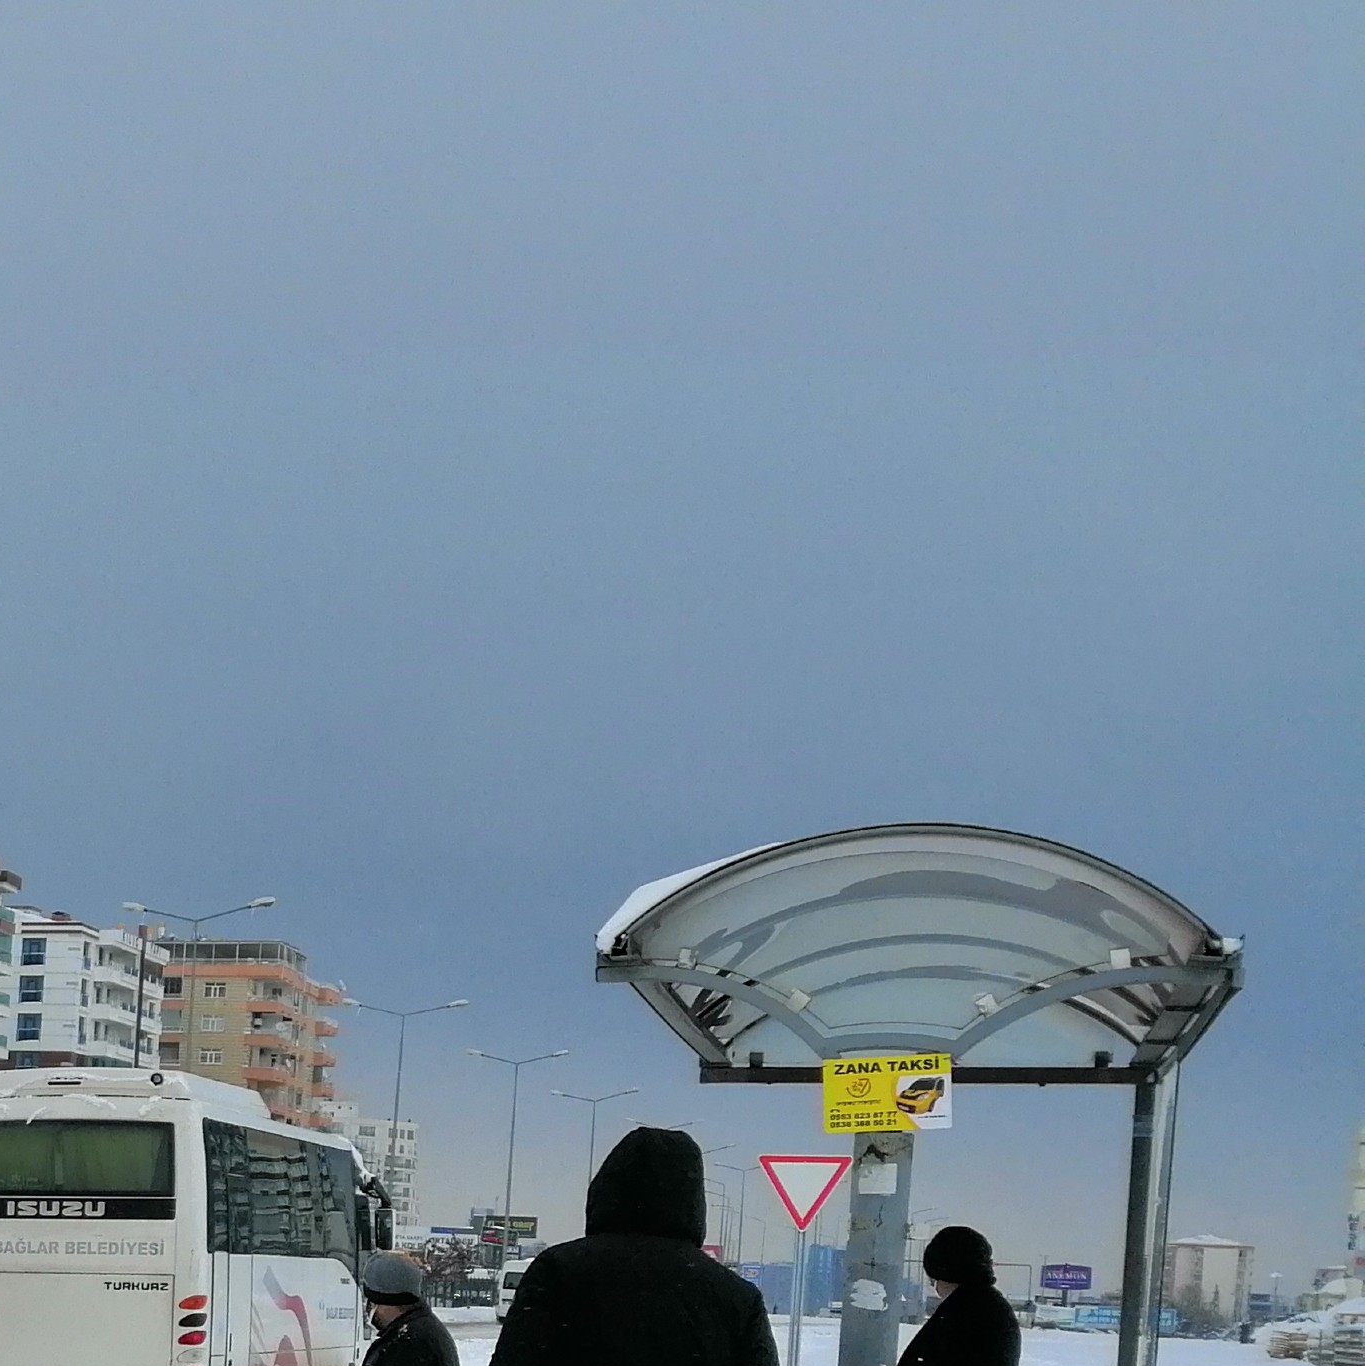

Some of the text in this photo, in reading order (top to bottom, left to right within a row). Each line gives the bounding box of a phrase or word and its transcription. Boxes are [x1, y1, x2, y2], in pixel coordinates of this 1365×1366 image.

[834, 1056, 940, 1075] ZANA TAKSİ
[7, 1201, 106, 1217] ISUZU
[65, 1239, 165, 1256] BELEDİYESİ
[1046, 1271, 1088, 1281] ANEMON
[104, 1282, 169, 1290] TURKUAZ
